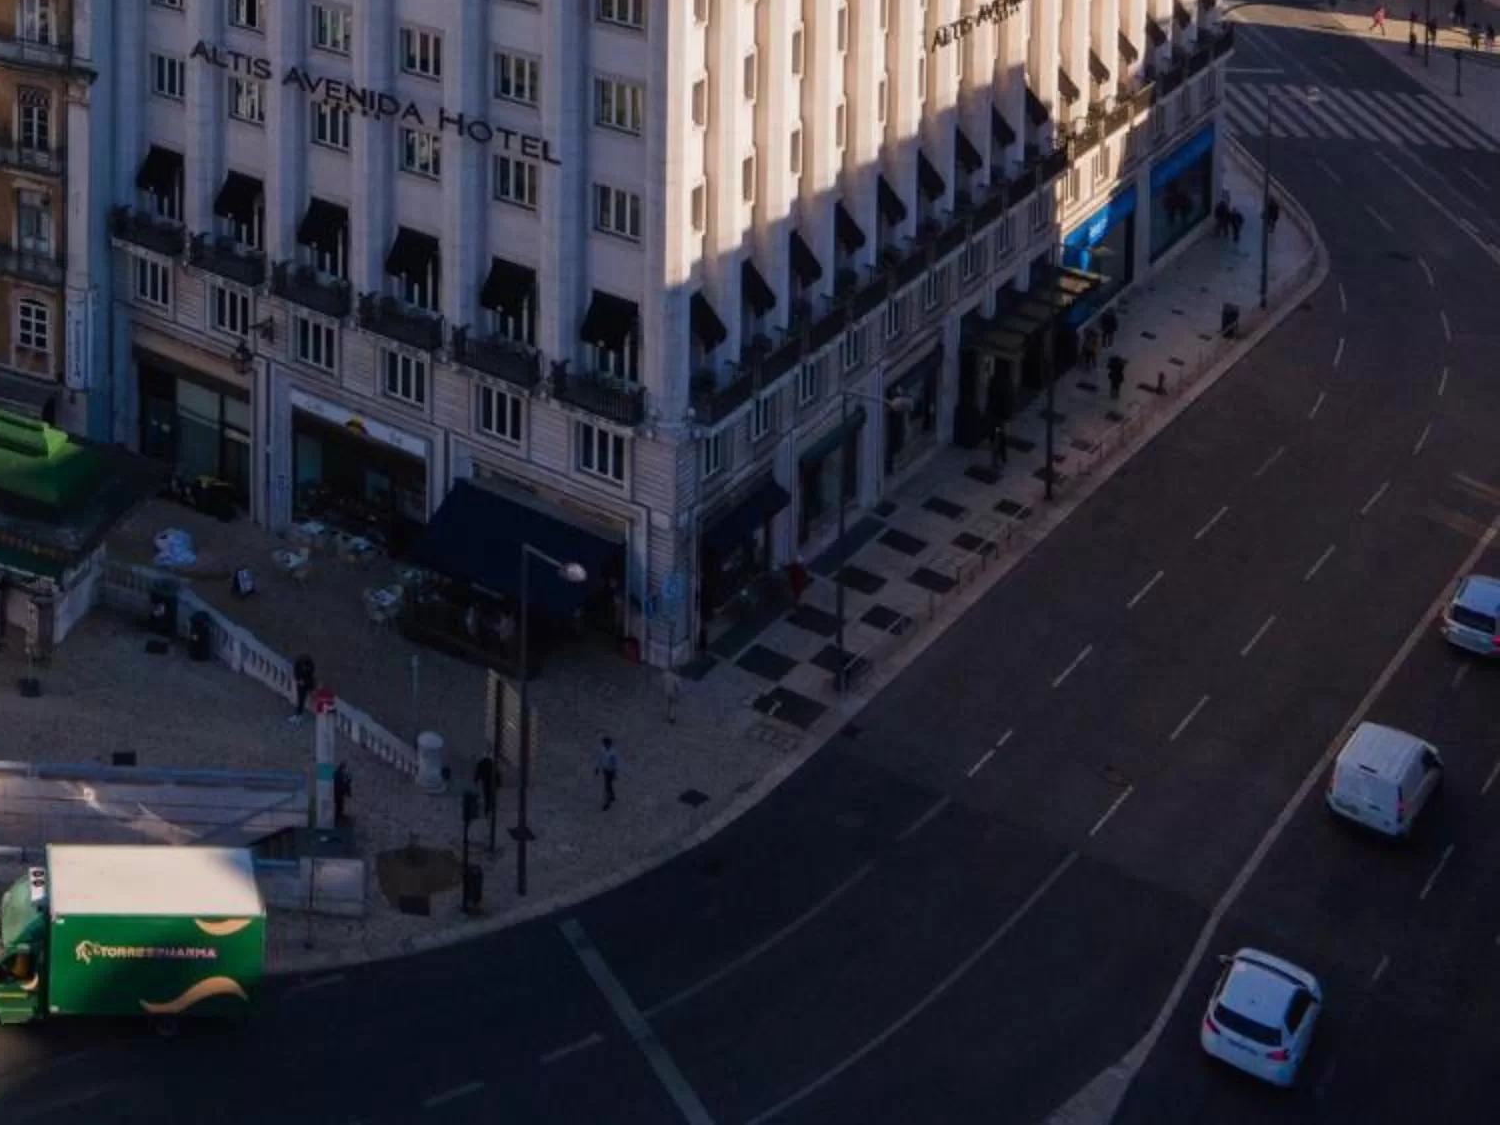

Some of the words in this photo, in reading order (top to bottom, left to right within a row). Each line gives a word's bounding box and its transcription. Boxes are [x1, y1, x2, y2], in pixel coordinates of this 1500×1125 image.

[190, 39, 271, 80] ALTIS
[282, 66, 424, 125] AVENIDA
[437, 106, 562, 165] HOTEL
